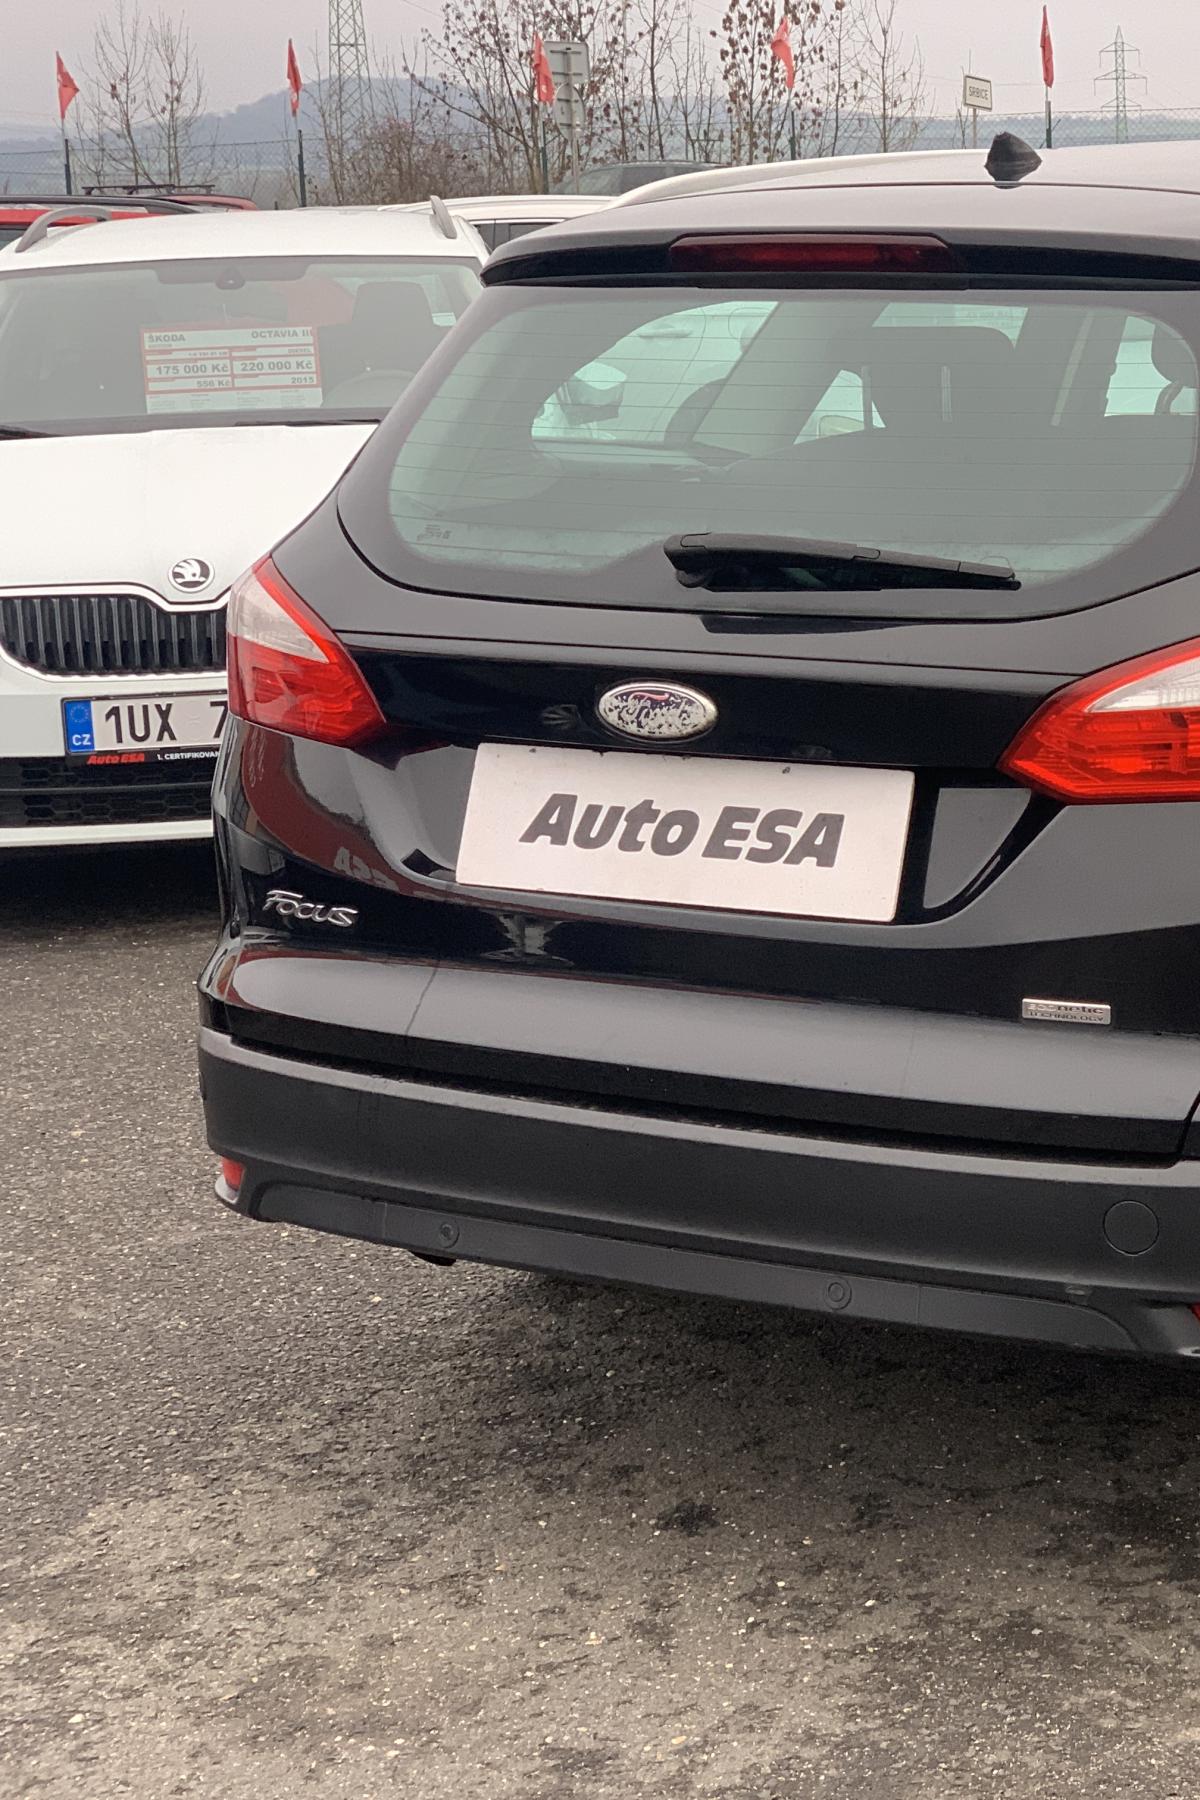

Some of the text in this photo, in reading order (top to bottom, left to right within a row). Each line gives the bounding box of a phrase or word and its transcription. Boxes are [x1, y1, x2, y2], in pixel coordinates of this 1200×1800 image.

[251, 329, 298, 339] OCTAVIA
[156, 363, 229, 375] 175 000 Kč
[241, 360, 313, 371] 220 000 Kč
[290, 376, 314, 384] 2015
[105, 703, 177, 743] 1UX
[72, 734, 91, 746] CZ
[87, 753, 145, 765] Auto ESA
[519, 793, 845, 868] Auto ESA
